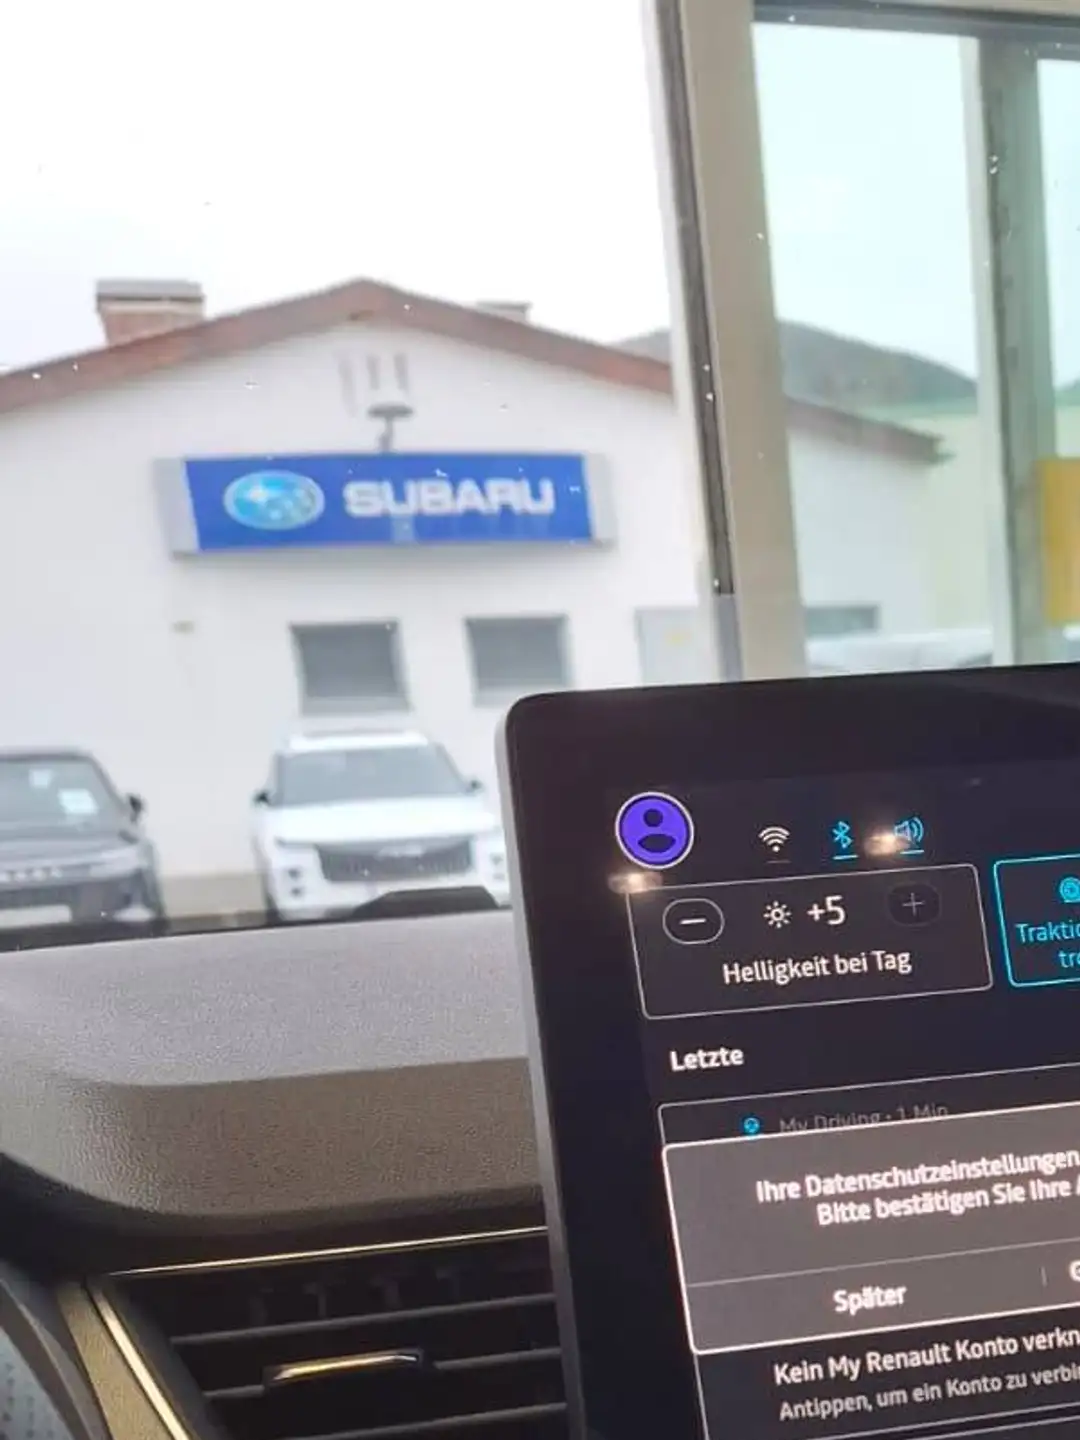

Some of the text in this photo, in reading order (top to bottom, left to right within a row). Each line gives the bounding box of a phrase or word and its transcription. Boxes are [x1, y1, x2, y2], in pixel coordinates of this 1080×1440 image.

[343, 478, 555, 518] SUBARU
[806, 895, 845, 926] +5
[722, 950, 913, 987] Helligkeit bei Tag
[669, 1045, 745, 1073] Letzte
[756, 1180, 801, 1203] Ihre
[805, 1151, 1080, 1197] Datenschutzeinstellungen
[816, 1202, 872, 1226] Bitte
[875, 1190, 990, 1218] bestätigen
[992, 1184, 1026, 1205] Sie
[1030, 1178, 1072, 1201] Ihre
[833, 1285, 907, 1316] Später
[774, 1361, 824, 1386] Kein
[828, 1355, 861, 1382] My
[865, 1344, 952, 1373] Renault
[955, 1336, 1019, 1361] Konto
[779, 1394, 873, 1421] Antippen,
[876, 1389, 908, 1407] um
[913, 1383, 942, 1402] ein
[946, 1375, 1002, 1398] Konto
[1006, 1372, 1028, 1390] zu
